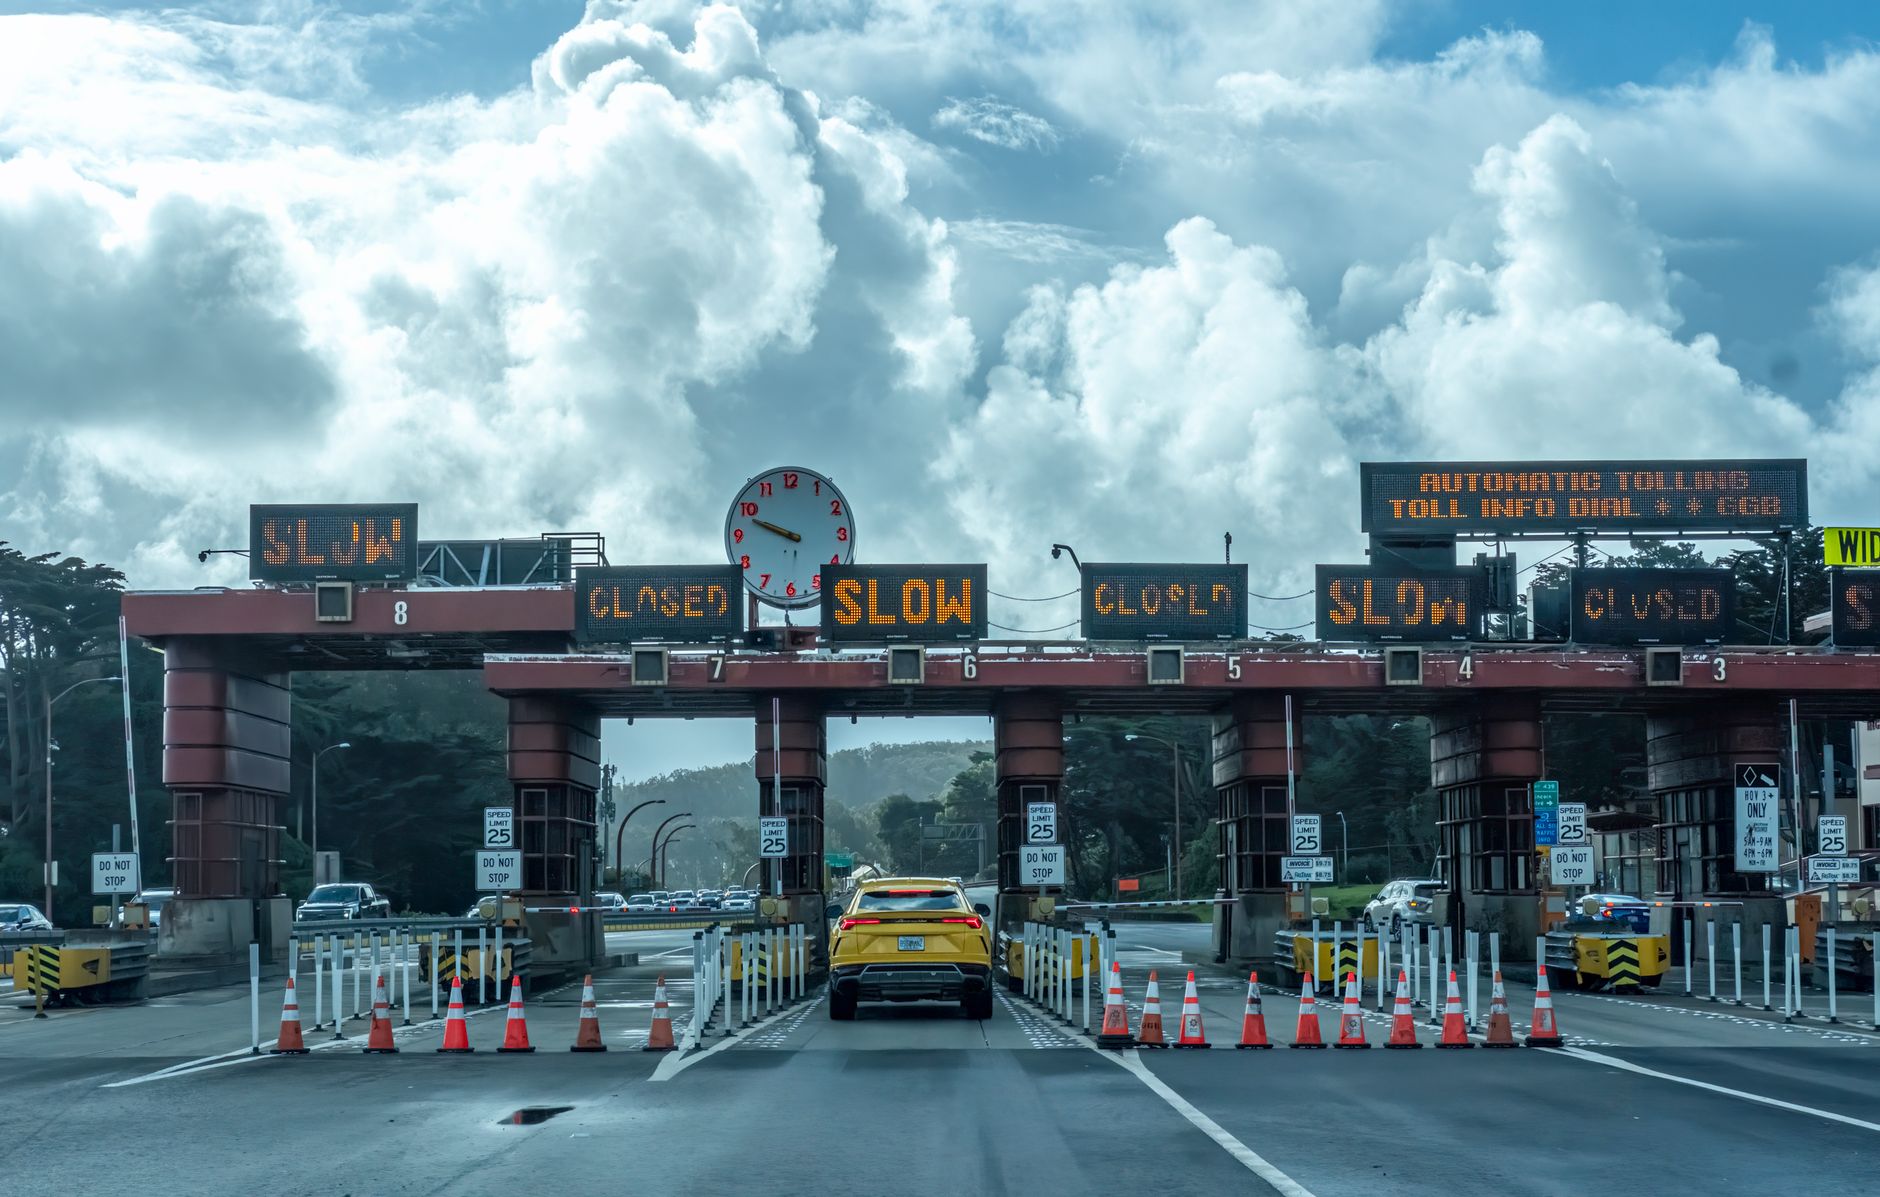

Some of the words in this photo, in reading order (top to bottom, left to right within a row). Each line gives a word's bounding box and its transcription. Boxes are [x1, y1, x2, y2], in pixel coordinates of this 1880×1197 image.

[783, 473, 798, 489] 12
[813, 480, 820, 496] 1
[1420, 472, 1600, 492] AUTOMATIC
[1615, 471, 1749, 491] TOLLING
[760, 482, 772, 497] 11
[740, 502, 759, 517] 10
[830, 500, 842, 516] 2
[1388, 499, 1468, 518] TOLL
[1481, 498, 1555, 518] INFO
[1569, 497, 1640, 517] DIAL
[734, 528, 744, 544] 9
[836, 527, 848, 542] 3
[741, 554, 750, 569] 8
[830, 554, 840, 565] 4
[760, 574, 772, 590] 7
[786, 582, 796, 597] 6
[812, 574, 821, 590] 5
[834, 579, 971, 625] SLOW
[394, 601, 408, 625] 8
[710, 657, 723, 679] 7
[963, 655, 977, 679] 6
[1228, 656, 1241, 680] 5
[1458, 656, 1474, 679] 4
[1713, 657, 1726, 681] 3
[1744, 791, 1758, 801] HOV
[1747, 803, 1767, 818] ONLY
[487, 828, 511, 844] 25
[1030, 824, 1054, 839] 25
[1560, 824, 1583, 840] 25
[763, 838, 786, 854] 25
[1295, 835, 1318, 850] 25
[1822, 836, 1845, 852] 25
[99, 861, 111, 871] DO
[114, 860, 131, 870] NOT
[483, 858, 495, 868] DO
[498, 858, 514, 868] NOT
[1026, 852, 1038, 863] DO
[1042, 852, 1057, 863] NOT
[1556, 853, 1568, 864] DO
[1572, 853, 1588, 863] NOT
[104, 876, 126, 886] STOP
[488, 873, 510, 883] STOP
[1032, 868, 1053, 878] STOP
[1562, 868, 1583, 879] STOP
